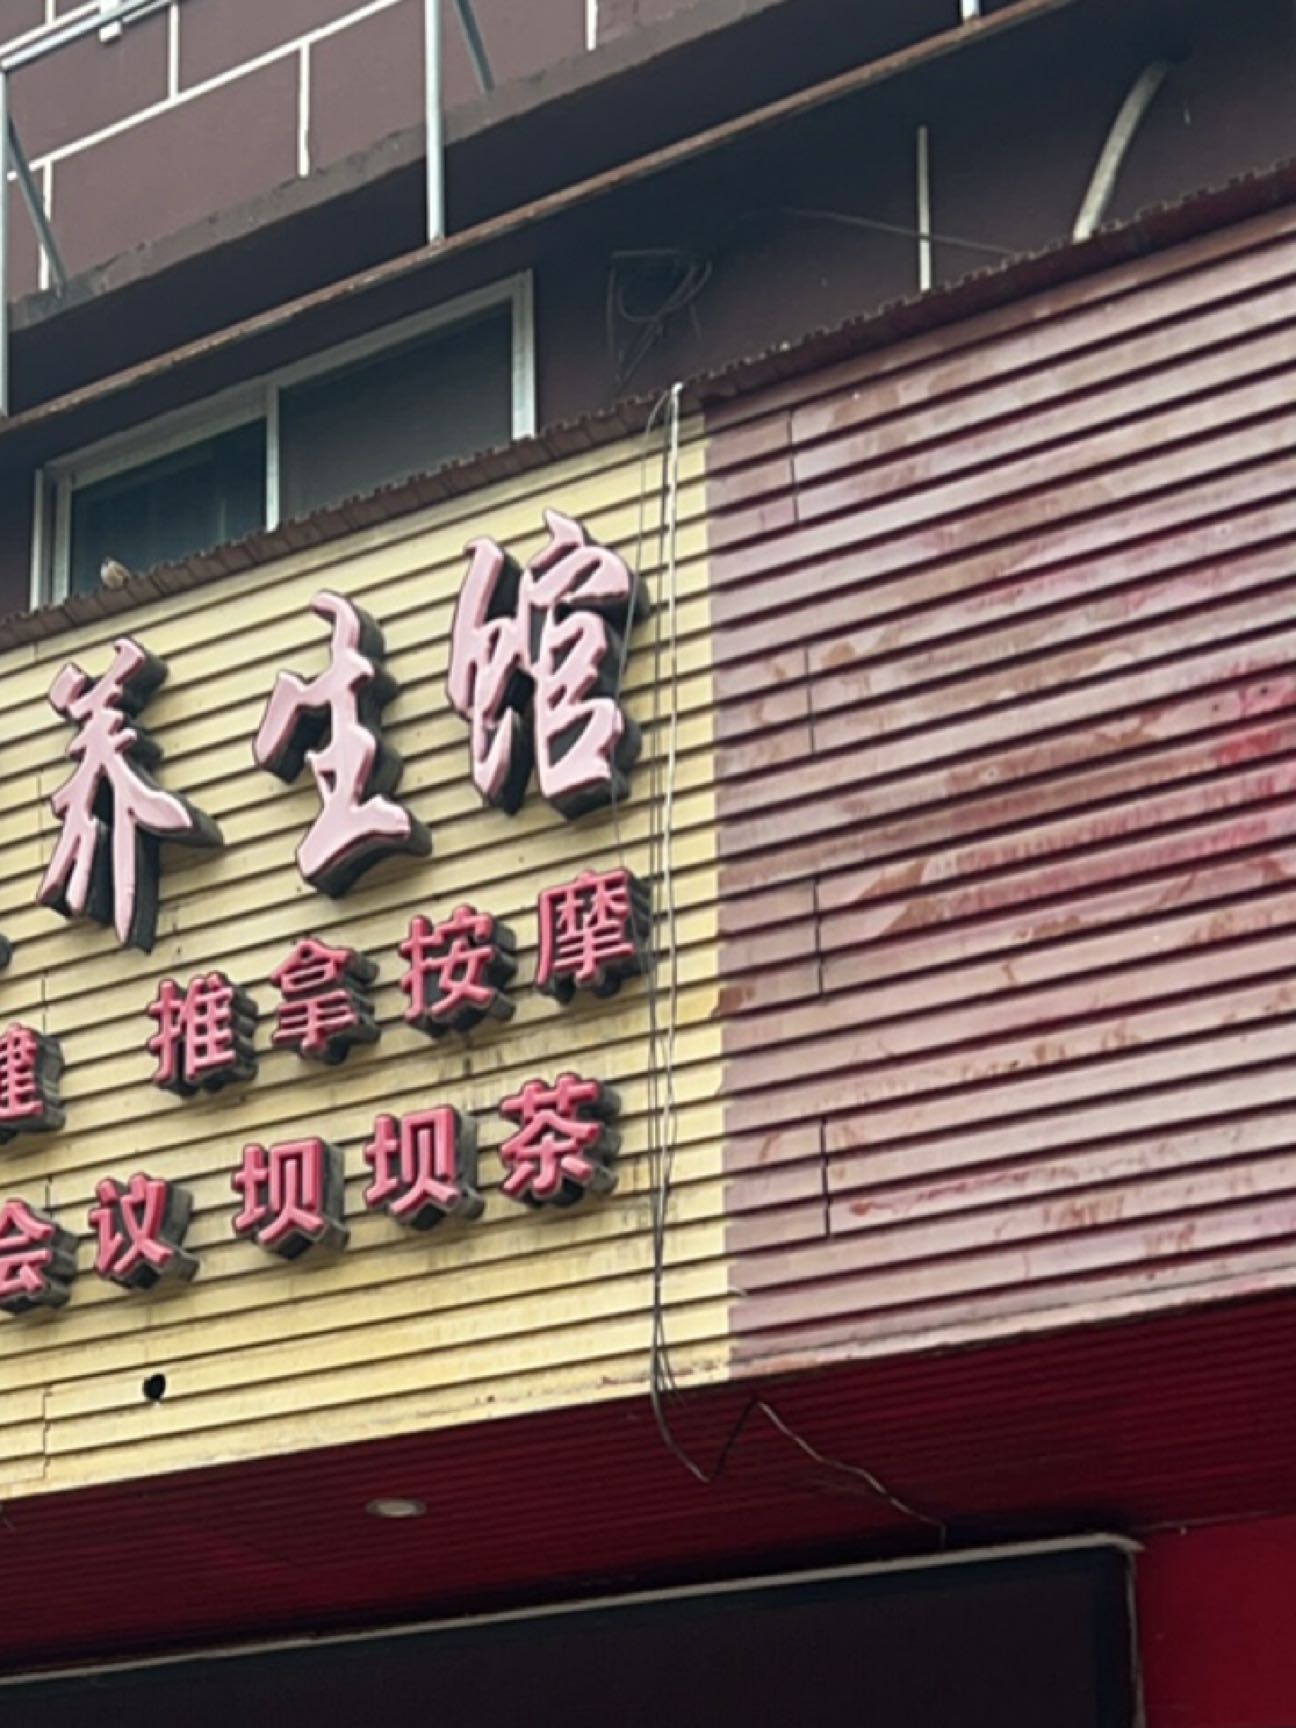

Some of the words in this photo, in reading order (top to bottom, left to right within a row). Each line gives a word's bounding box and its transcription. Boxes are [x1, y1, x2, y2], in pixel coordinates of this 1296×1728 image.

[146, 867, 637, 1084] 推拿按摩
[231, 1072, 609, 1246] 坝坝茶
